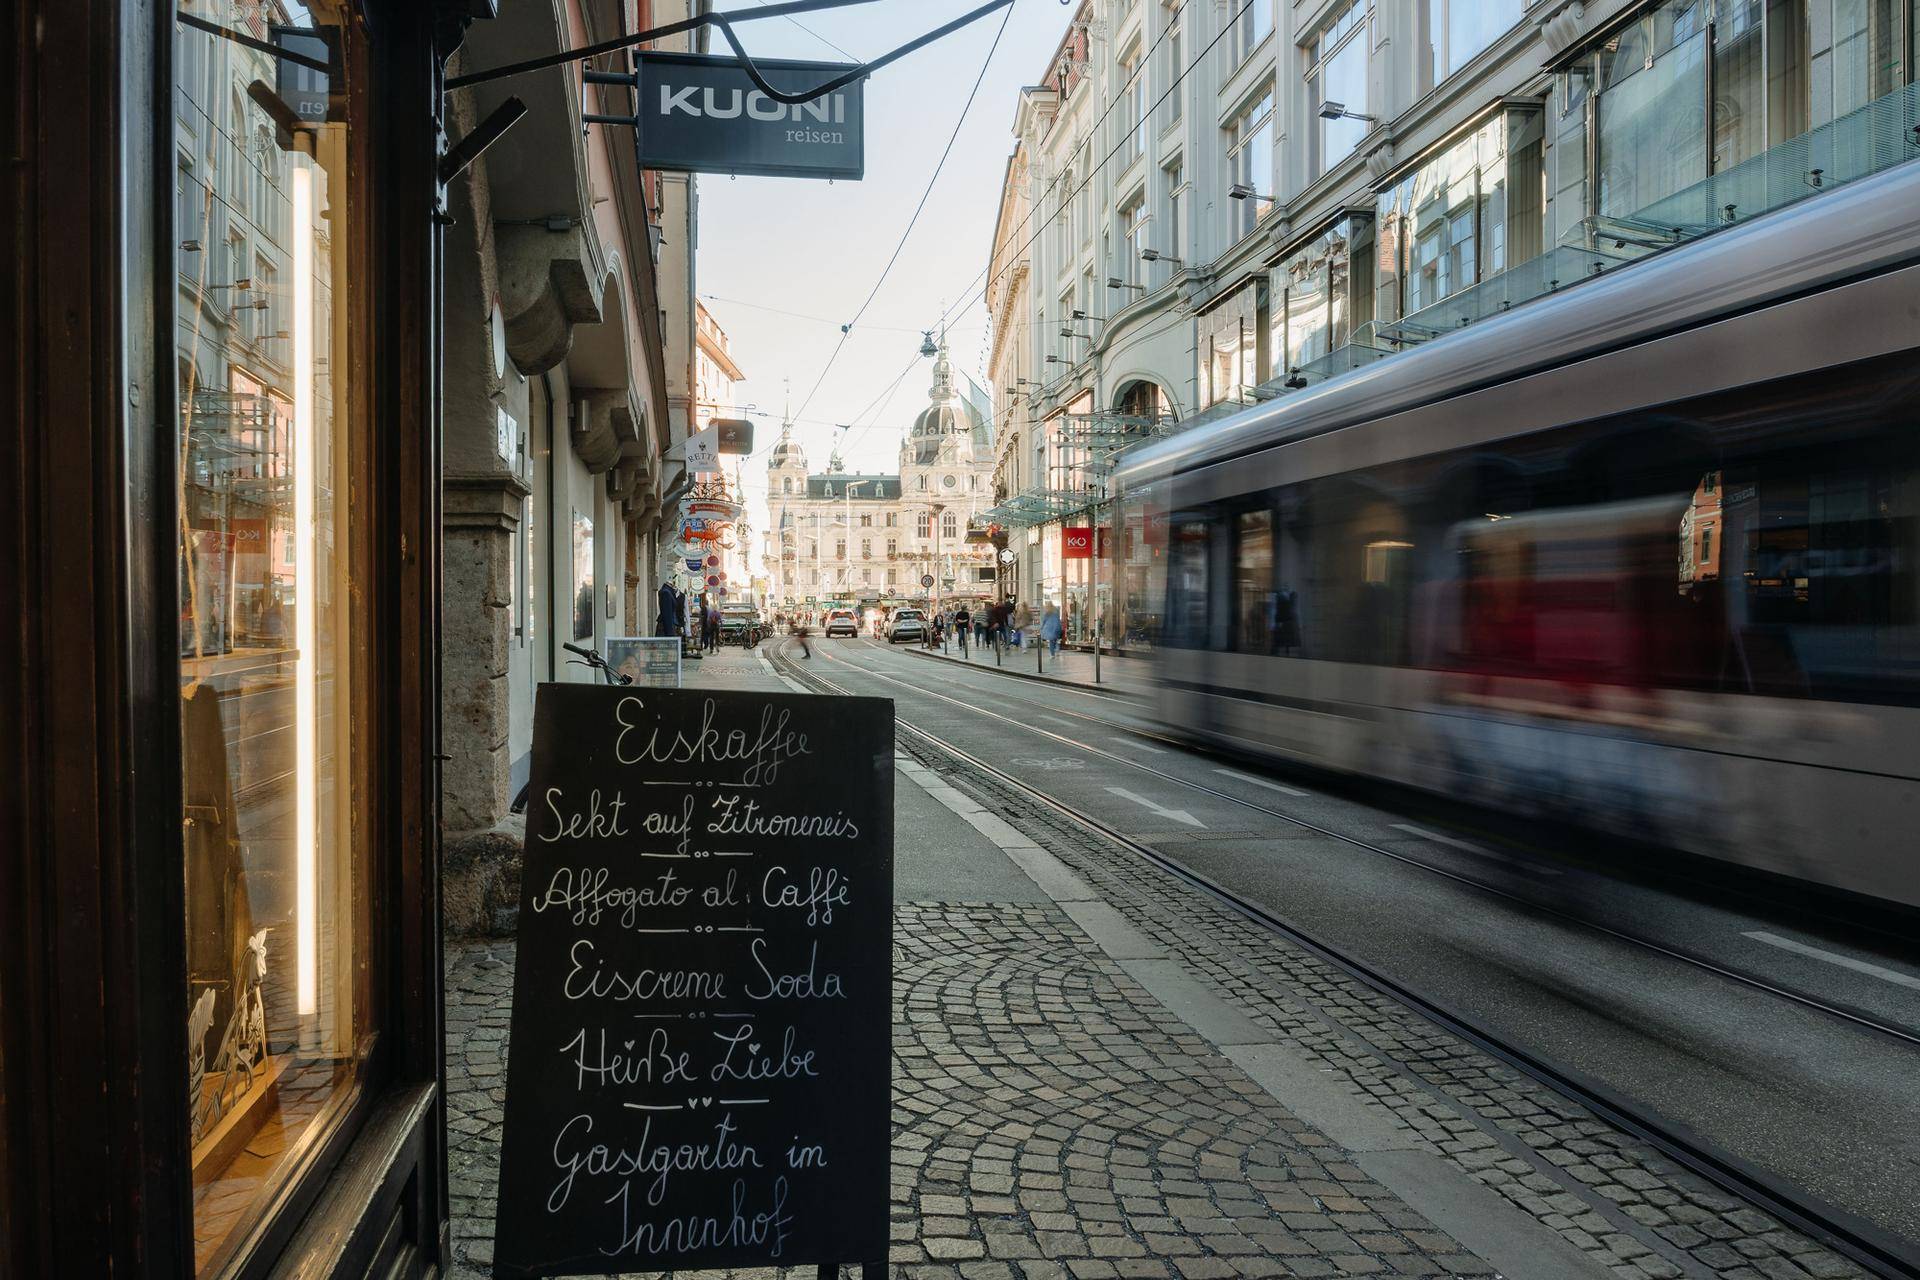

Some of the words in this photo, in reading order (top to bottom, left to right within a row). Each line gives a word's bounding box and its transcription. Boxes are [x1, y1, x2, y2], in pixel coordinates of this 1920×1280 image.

[660, 84, 845, 123] KUONI
[786, 126, 844, 144] reisen
[616, 697, 814, 786] Eiskaffee
[538, 788, 628, 842] Sekt
[642, 794, 694, 855] auf
[707, 795, 859, 839] Zitroneneis
[533, 867, 693, 928] Affogato
[702, 869, 739, 906] al
[763, 866, 851, 927] Caffè
[564, 940, 726, 1000] Eiscreme
[745, 938, 846, 999] Soda
[559, 1028, 698, 1091] Heiße
[711, 1024, 819, 1081] Liebe
[548, 1112, 764, 1212] Gastgarten
[785, 1135, 827, 1168] im
[599, 1176, 793, 1257] Innenhof
